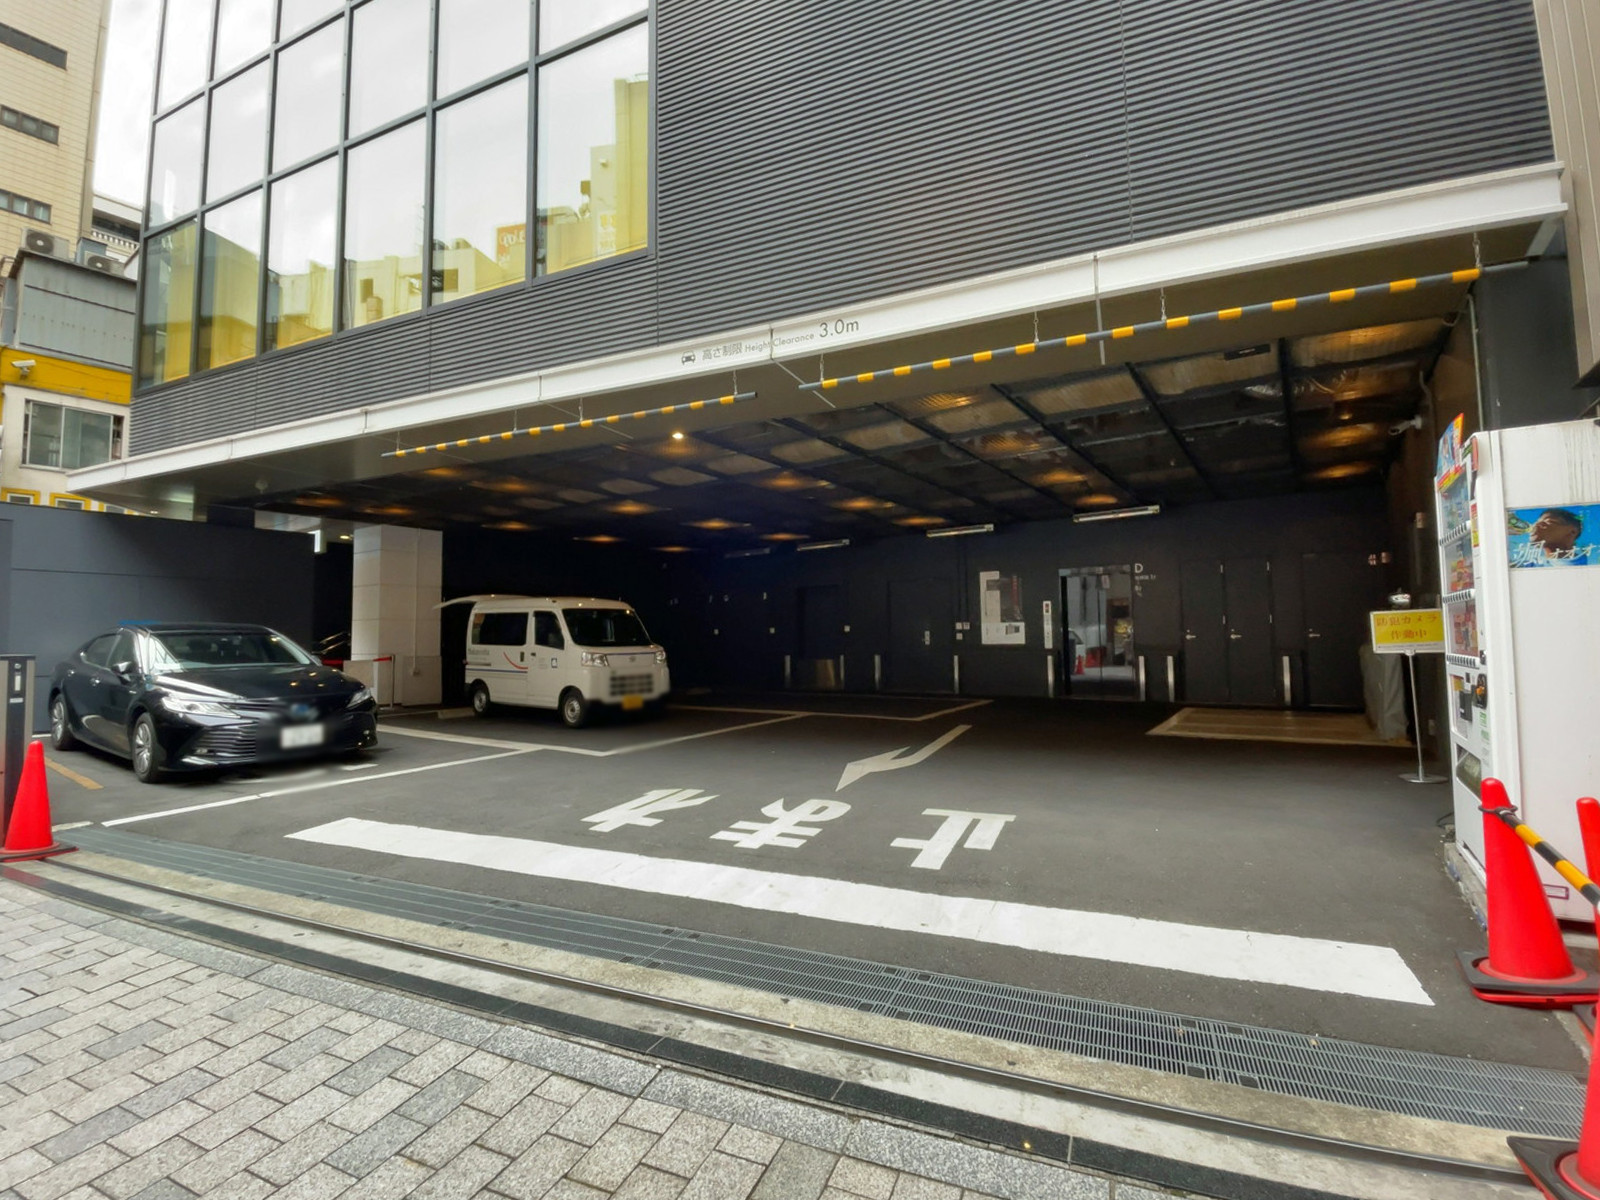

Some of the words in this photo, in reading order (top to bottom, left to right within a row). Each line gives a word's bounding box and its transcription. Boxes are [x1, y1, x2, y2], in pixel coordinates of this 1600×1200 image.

[702, 342, 743, 360] 高さ制限
[745, 340, 770, 352] Height
[773, 333, 815, 346] Clearance
[819, 319, 859, 338] 3.0m
[1510, 540, 1600, 568] 颯オオオ
[580, 788, 1017, 870] 止まれ
